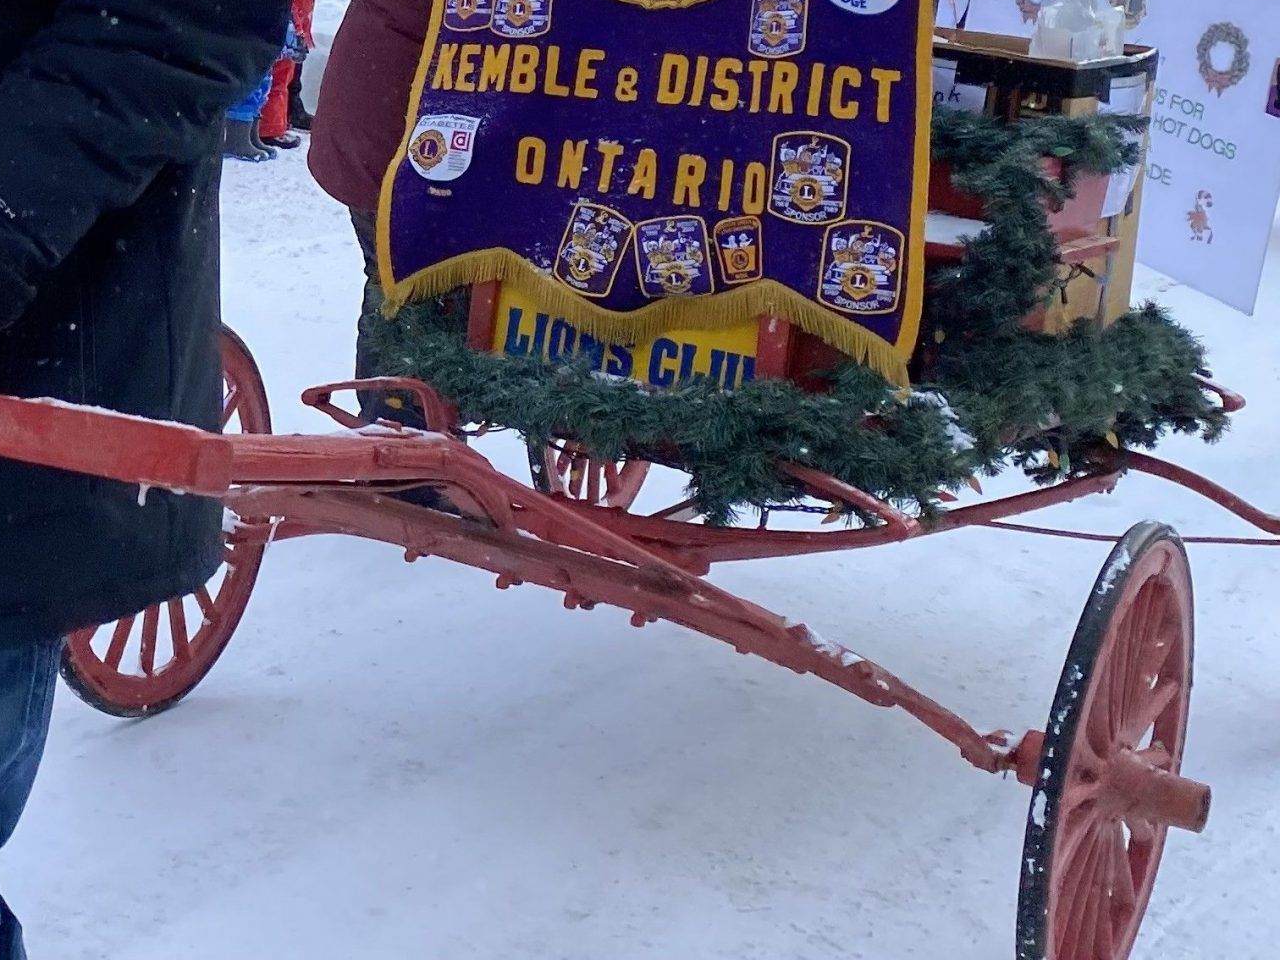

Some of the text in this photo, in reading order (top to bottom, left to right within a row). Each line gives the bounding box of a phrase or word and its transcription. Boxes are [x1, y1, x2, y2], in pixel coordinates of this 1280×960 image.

[431, 43, 902, 123] KEMBLE & DISTRICT
[1169, 93, 1205, 121] FOR
[420, 120, 475, 131] DIABETES
[1153, 112, 1237, 160] HOT DOGS
[514, 135, 767, 216] ONTARIO
[803, 185, 813, 200] L
[784, 206, 827, 222] SPONSOR
[853, 274, 865, 288] L
[834, 296, 880, 310] SPONSOR
